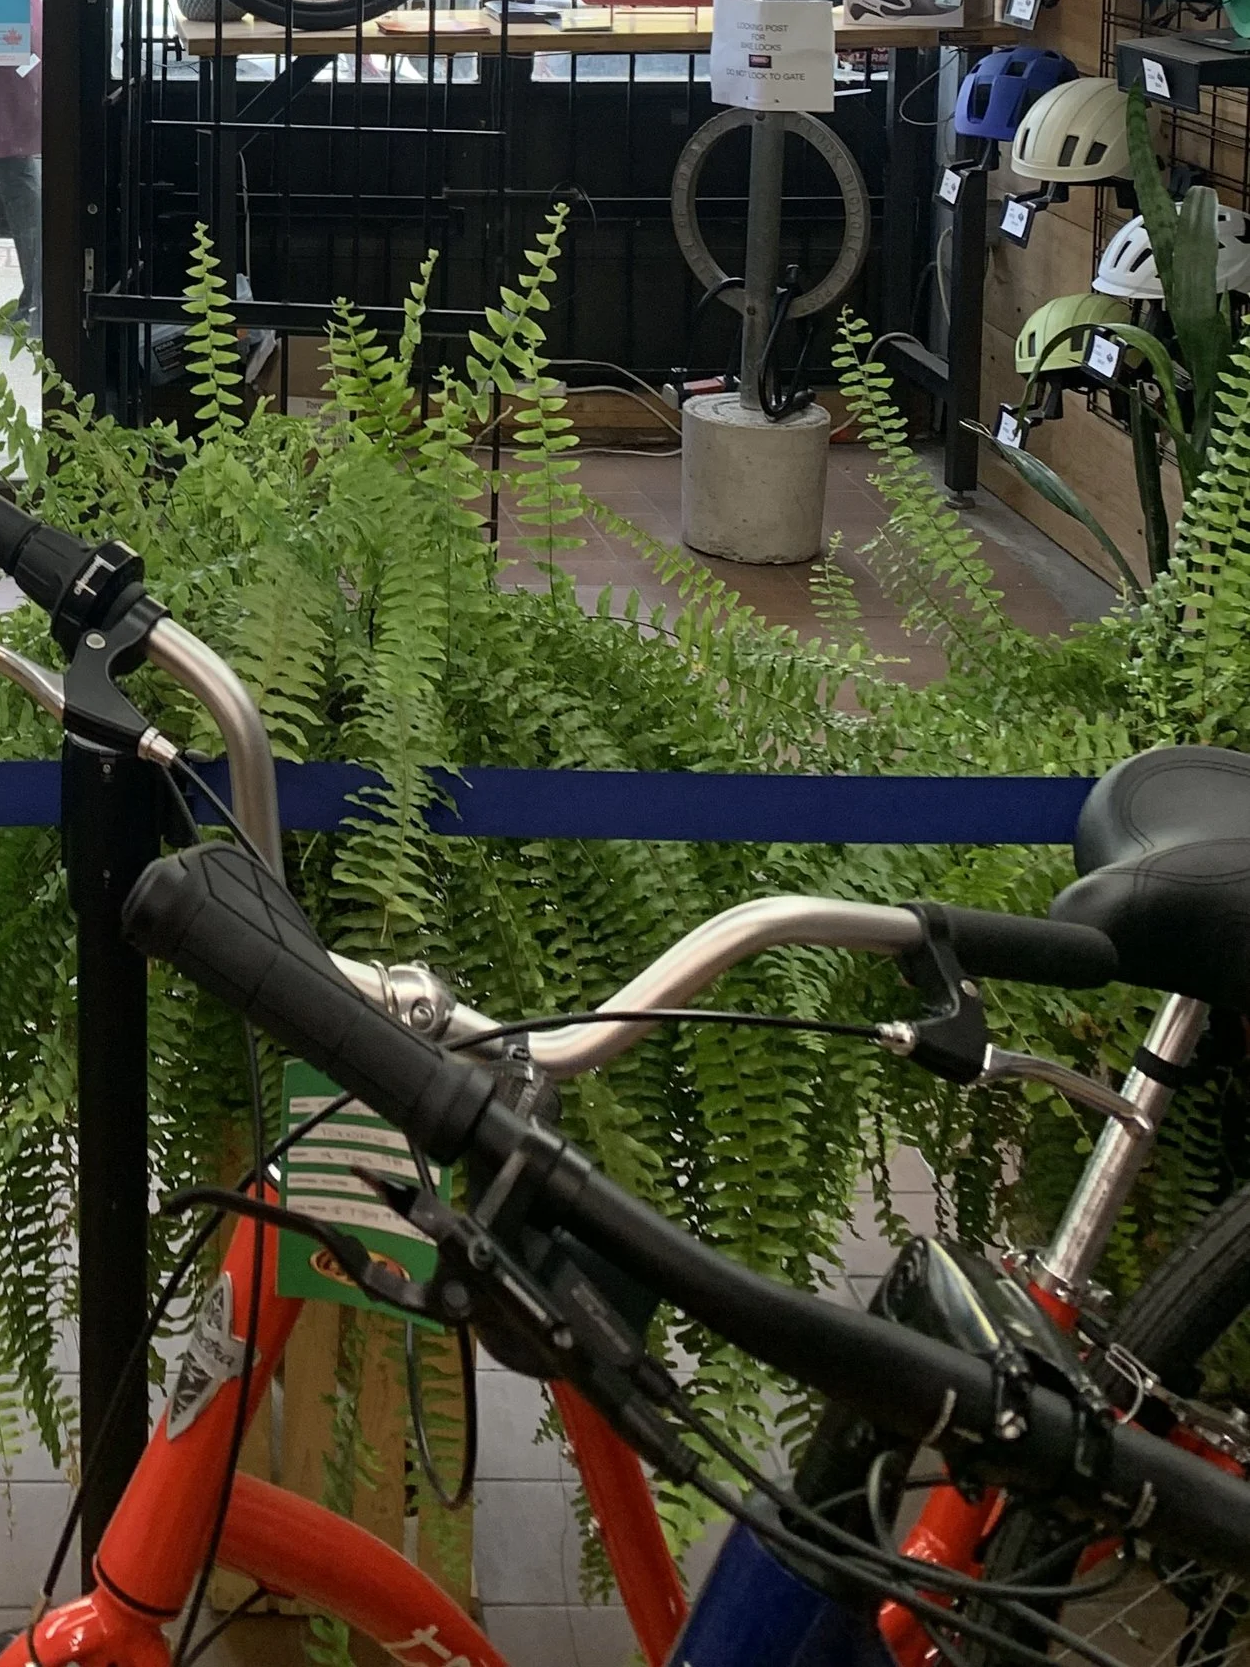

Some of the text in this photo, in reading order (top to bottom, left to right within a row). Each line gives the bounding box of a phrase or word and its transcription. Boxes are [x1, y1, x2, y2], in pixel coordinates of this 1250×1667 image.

[737, 22, 789, 32] LOCKING POST
[751, 33, 766, 41] FOR
[741, 42, 782, 51] BIKE LOCKS
[726, 68, 735, 76] DO
[748, 71, 768, 80] LOCK
[769, 72, 781, 81] TO
[783, 73, 806, 81] GATE
